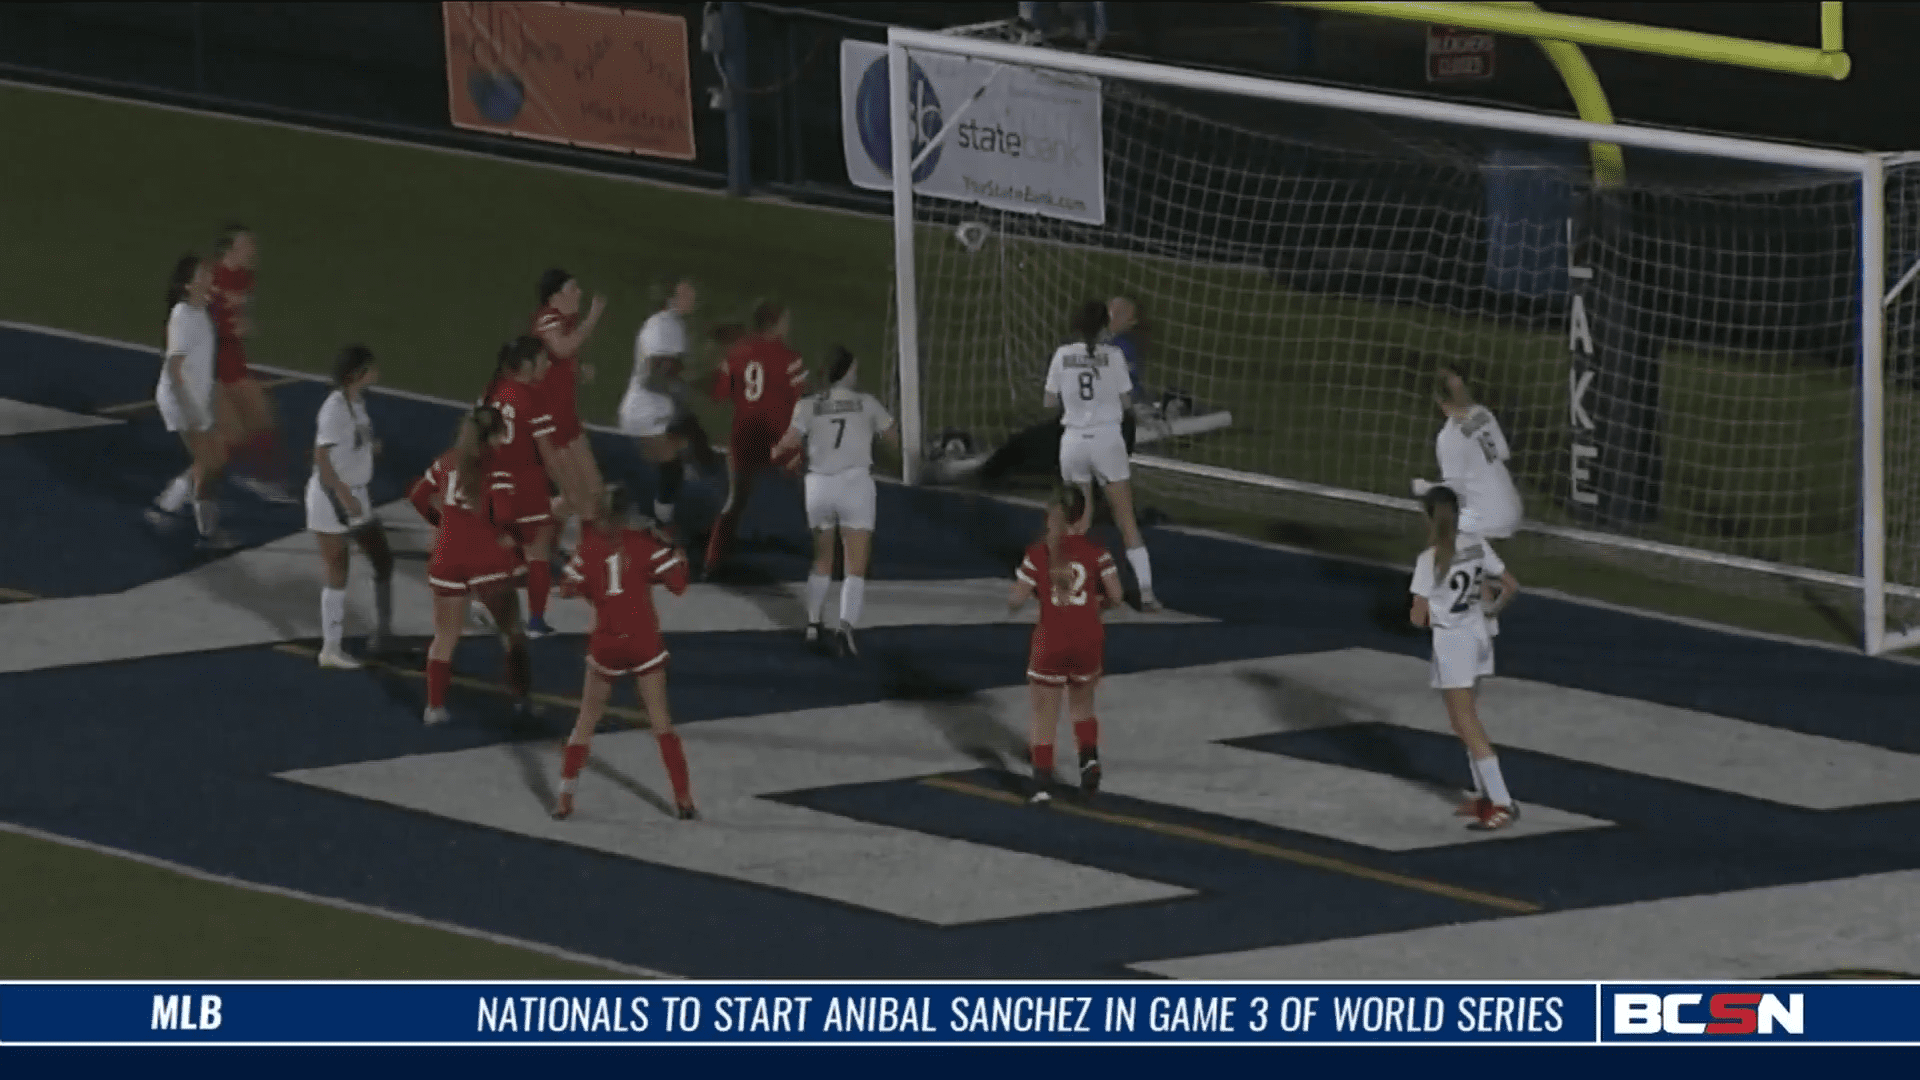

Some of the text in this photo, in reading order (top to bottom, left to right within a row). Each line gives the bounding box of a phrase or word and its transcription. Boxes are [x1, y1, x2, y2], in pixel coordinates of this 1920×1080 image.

[743, 359, 766, 403] 9
[1565, 217, 1600, 506] LAKE
[1078, 372, 1094, 401] 8
[830, 418, 846, 450] 7
[604, 551, 625, 597] 1
